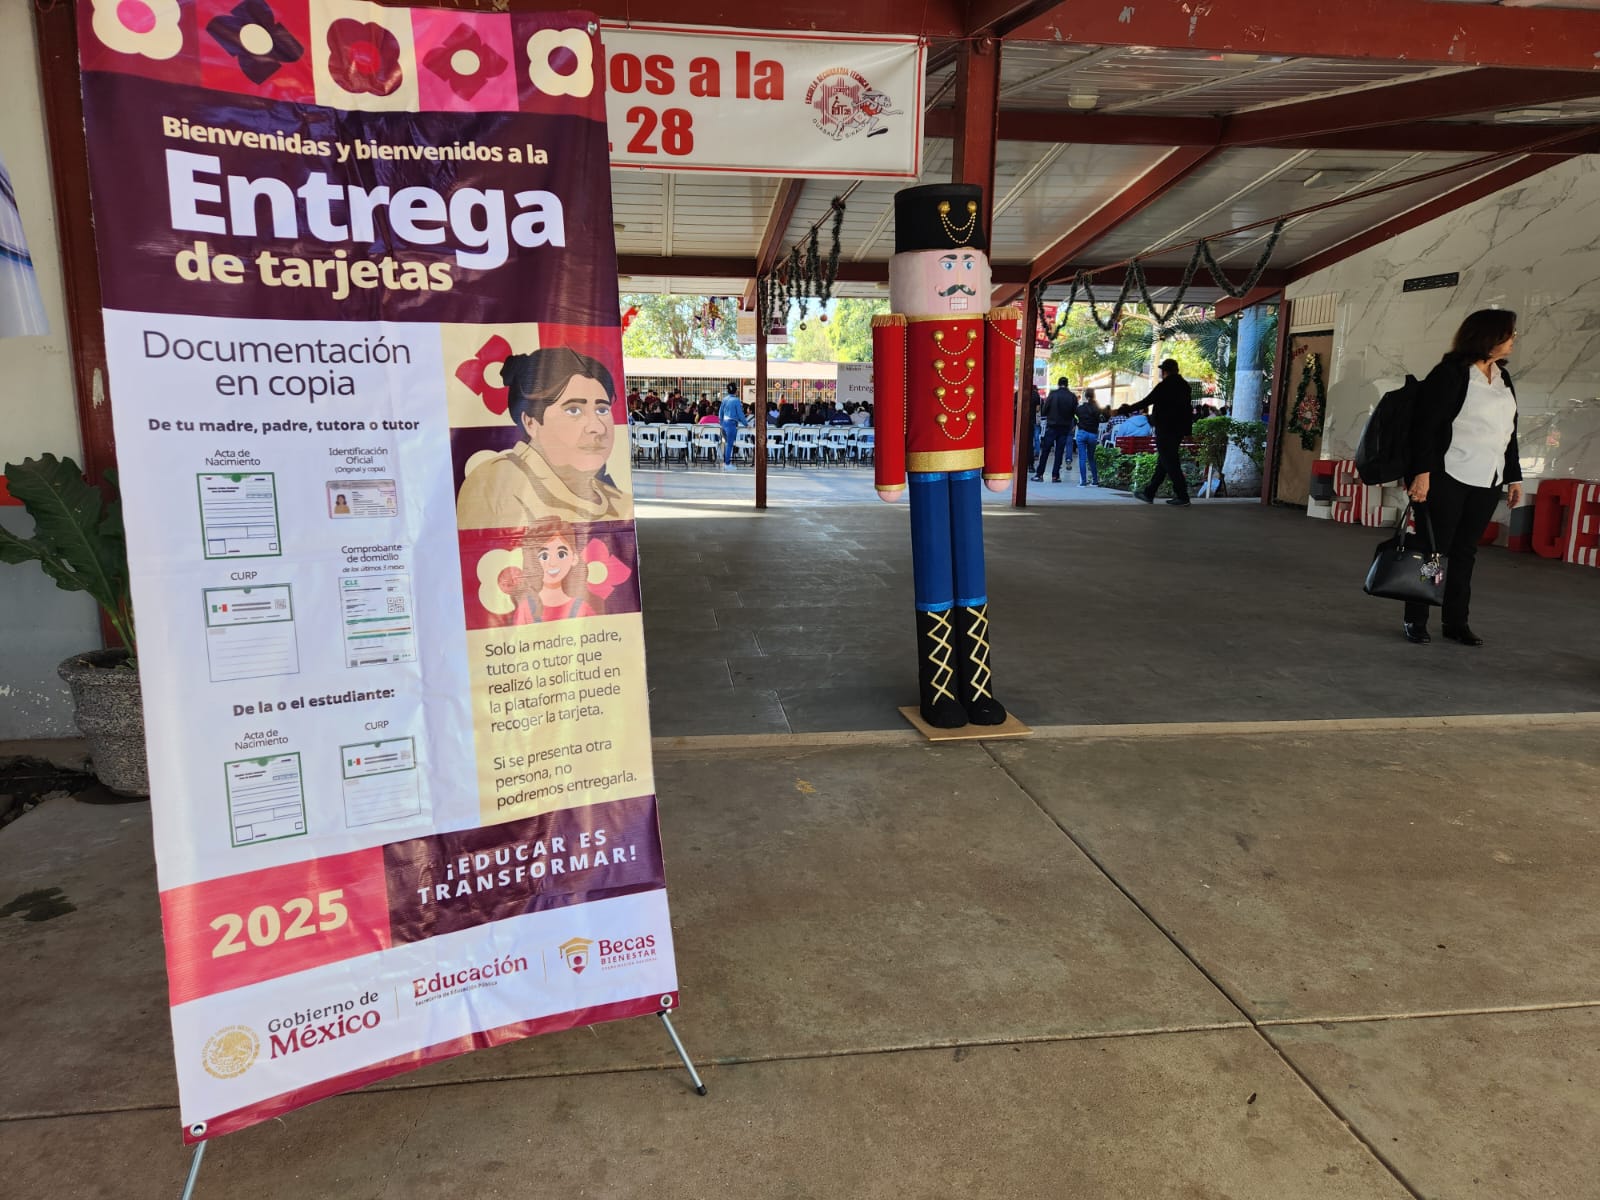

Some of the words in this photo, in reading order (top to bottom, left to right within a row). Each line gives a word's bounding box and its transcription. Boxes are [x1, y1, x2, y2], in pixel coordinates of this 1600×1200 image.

[606, 51, 675, 95] os
[689, 57, 721, 98] a
[735, 50, 784, 100] la
[162, 115, 331, 158] Bienvenidas
[336, 141, 350, 162] y
[356, 138, 505, 163] bienvenidos
[508, 146, 523, 164] a
[526, 143, 548, 165] la
[626, 106, 694, 156] 28
[165, 148, 565, 270] Entrega
[175, 241, 244, 284] de
[256, 249, 453, 300] tarjetas
[143, 329, 411, 366] Documentación
[216, 375, 262, 396] en
[268, 369, 356, 402] copia
[848, 384, 873, 393] Entreg
[148, 418, 171, 431] De
[176, 419, 195, 431] tu
[200, 419, 258, 434] madre,
[262, 418, 313, 435] padre,
[316, 419, 365, 431] tutora
[369, 421, 379, 431] o
[382, 419, 420, 431] tutor
[205, 457, 261, 466] Nacimiento
[214, 449, 236, 458] Acta
[237, 449, 251, 458] de
[328, 446, 389, 456] Identificación
[345, 456, 374, 464] Oficial
[341, 543, 403, 556] Comprobante
[346, 555, 359, 563] de
[359, 553, 400, 562] domicilio
[230, 571, 258, 581] CURP
[485, 642, 516, 657] Solo
[519, 639, 530, 653] la
[533, 634, 577, 651] madre,
[580, 629, 622, 646] padre,
[486, 660, 529, 676] tutora
[532, 659, 541, 670] o
[543, 653, 574, 668] tutor
[576, 650, 602, 666] que
[488, 676, 533, 695] realizó
[536, 675, 547, 688] la
[549, 666, 601, 685] solicitud
[604, 666, 621, 677] en
[232, 703, 255, 717] De
[258, 701, 273, 714] la
[276, 701, 287, 711] o
[290, 696, 305, 709] el
[308, 688, 395, 707] estudiante:
[489, 700, 501, 714] la
[505, 689, 576, 715] plataforma
[578, 682, 621, 701] puede
[364, 720, 390, 731] CURP
[491, 713, 543, 733] recoger
[546, 710, 556, 724] la
[558, 704, 604, 722] tarjeta.
[234, 736, 289, 751] Nacimiento
[243, 730, 265, 741] Acta
[266, 729, 279, 739] de
[493, 756, 506, 770] Si
[509, 755, 524, 767] se
[527, 742, 583, 767] presenta
[585, 738, 612, 753] otra
[495, 767, 552, 793] persona,
[555, 762, 573, 776] no
[497, 782, 564, 811] podremos
[566, 769, 638, 793] entregarla.
[446, 836, 566, 881] ¡EDUCAR
[579, 829, 607, 849] ES
[417, 844, 637, 905] TRANSFORMAR!
[209, 888, 349, 959] 2025
[598, 934, 655, 957] Becas
[600, 949, 657, 965] BIENESTAR
[412, 954, 528, 999] Educación
[268, 999, 355, 1033] Gobierno
[359, 991, 379, 1006] de
[269, 1009, 381, 1060] México
